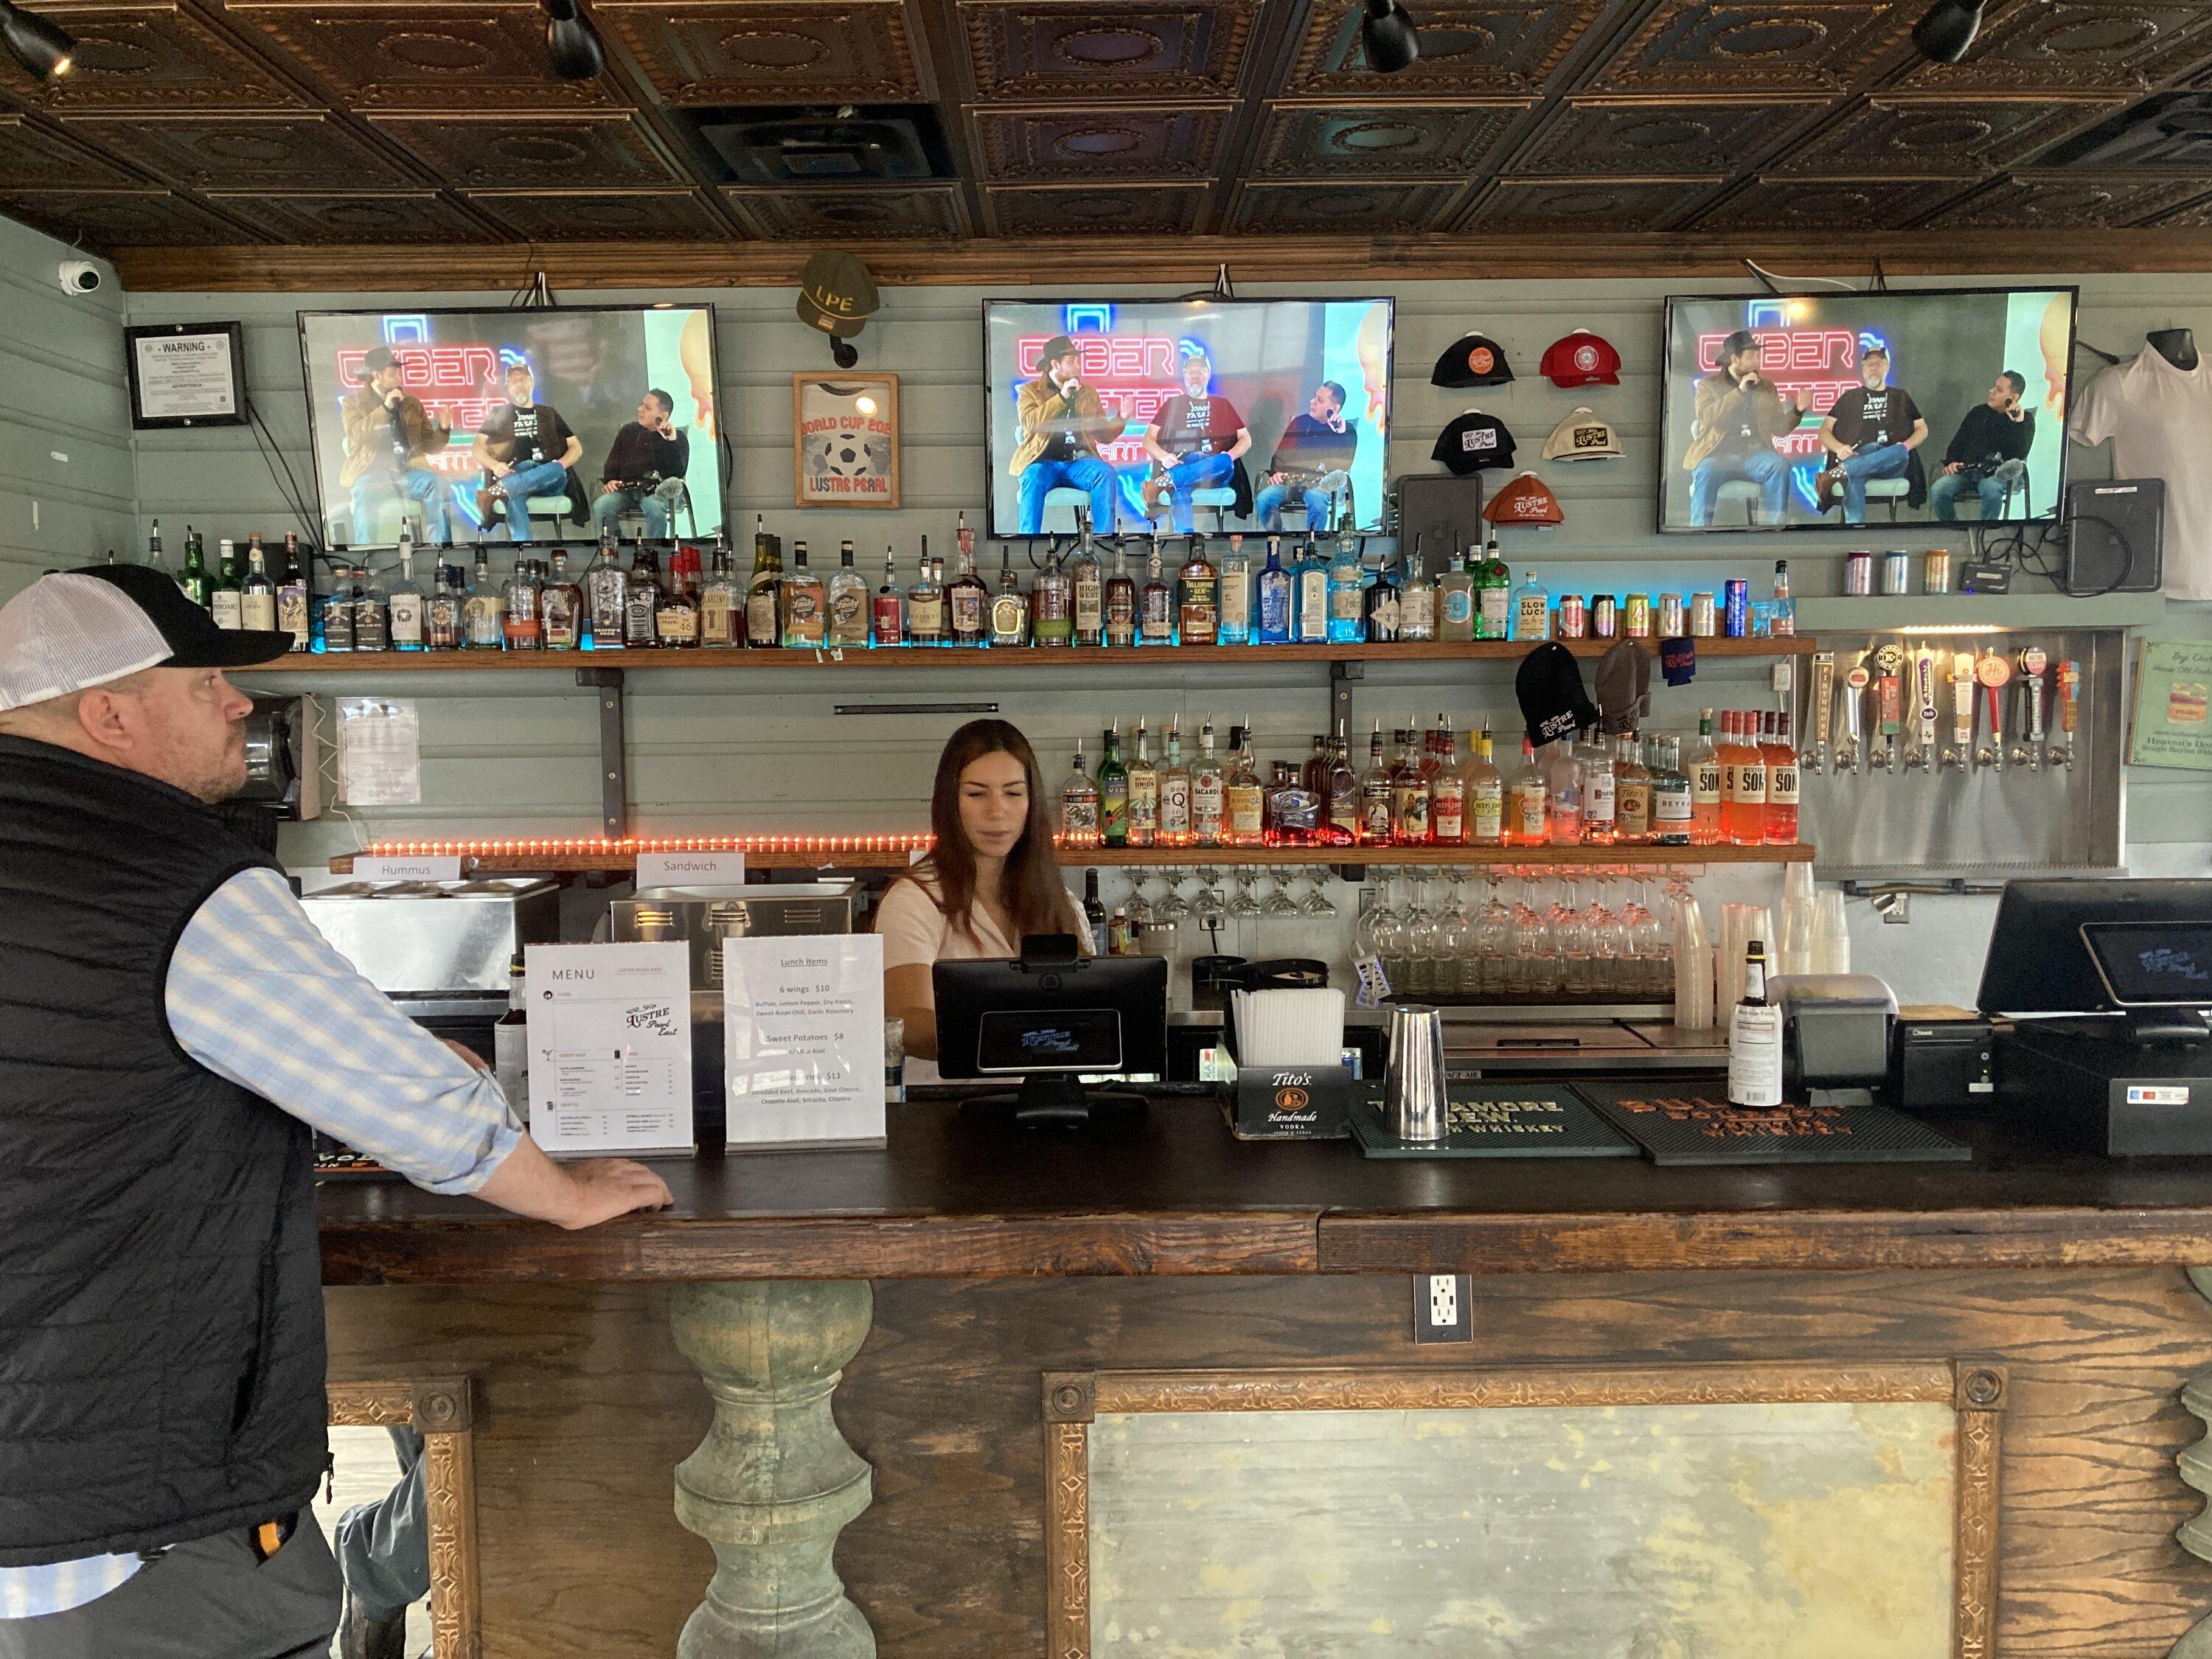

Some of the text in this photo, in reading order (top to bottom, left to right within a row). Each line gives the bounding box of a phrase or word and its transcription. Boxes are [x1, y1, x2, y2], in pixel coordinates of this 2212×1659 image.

[815, 285, 854, 312] LPE
[162, 341, 205, 352] WARNING
[1700, 331, 1854, 371] CBER
[1019, 338, 1174, 377] CBER
[338, 347, 497, 388] CBER
[841, 416, 865, 429] CUP
[1464, 431, 1495, 450] LUSTRE
[810, 476, 888, 493] LUSTRE PEARL
[1514, 496, 1548, 514] LUSTRE
[2171, 652, 2188, 664] Try
[1820, 667, 1829, 738] PINTHOUSE
[1542, 710, 1573, 740] LUSTRE
[2146, 737, 2192, 747] Heaven's
[1621, 789, 1645, 797] Tito's
[1172, 793, 1186, 808] Q
[381, 865, 431, 875] Hummus
[664, 860, 717, 872] Sandwich
[552, 970, 594, 980] MENU
[779, 984, 830, 995] 6 wings $10
[626, 1007, 669, 1029] LUSTRE
[646, 1019, 671, 1028] Pearl
[658, 1027, 678, 1036] East
[834, 1032, 844, 1040] $8
[827, 1072, 841, 1080] $13
[1272, 1071, 1312, 1086] Tito's
[1267, 1111, 1317, 1121] Handmade
